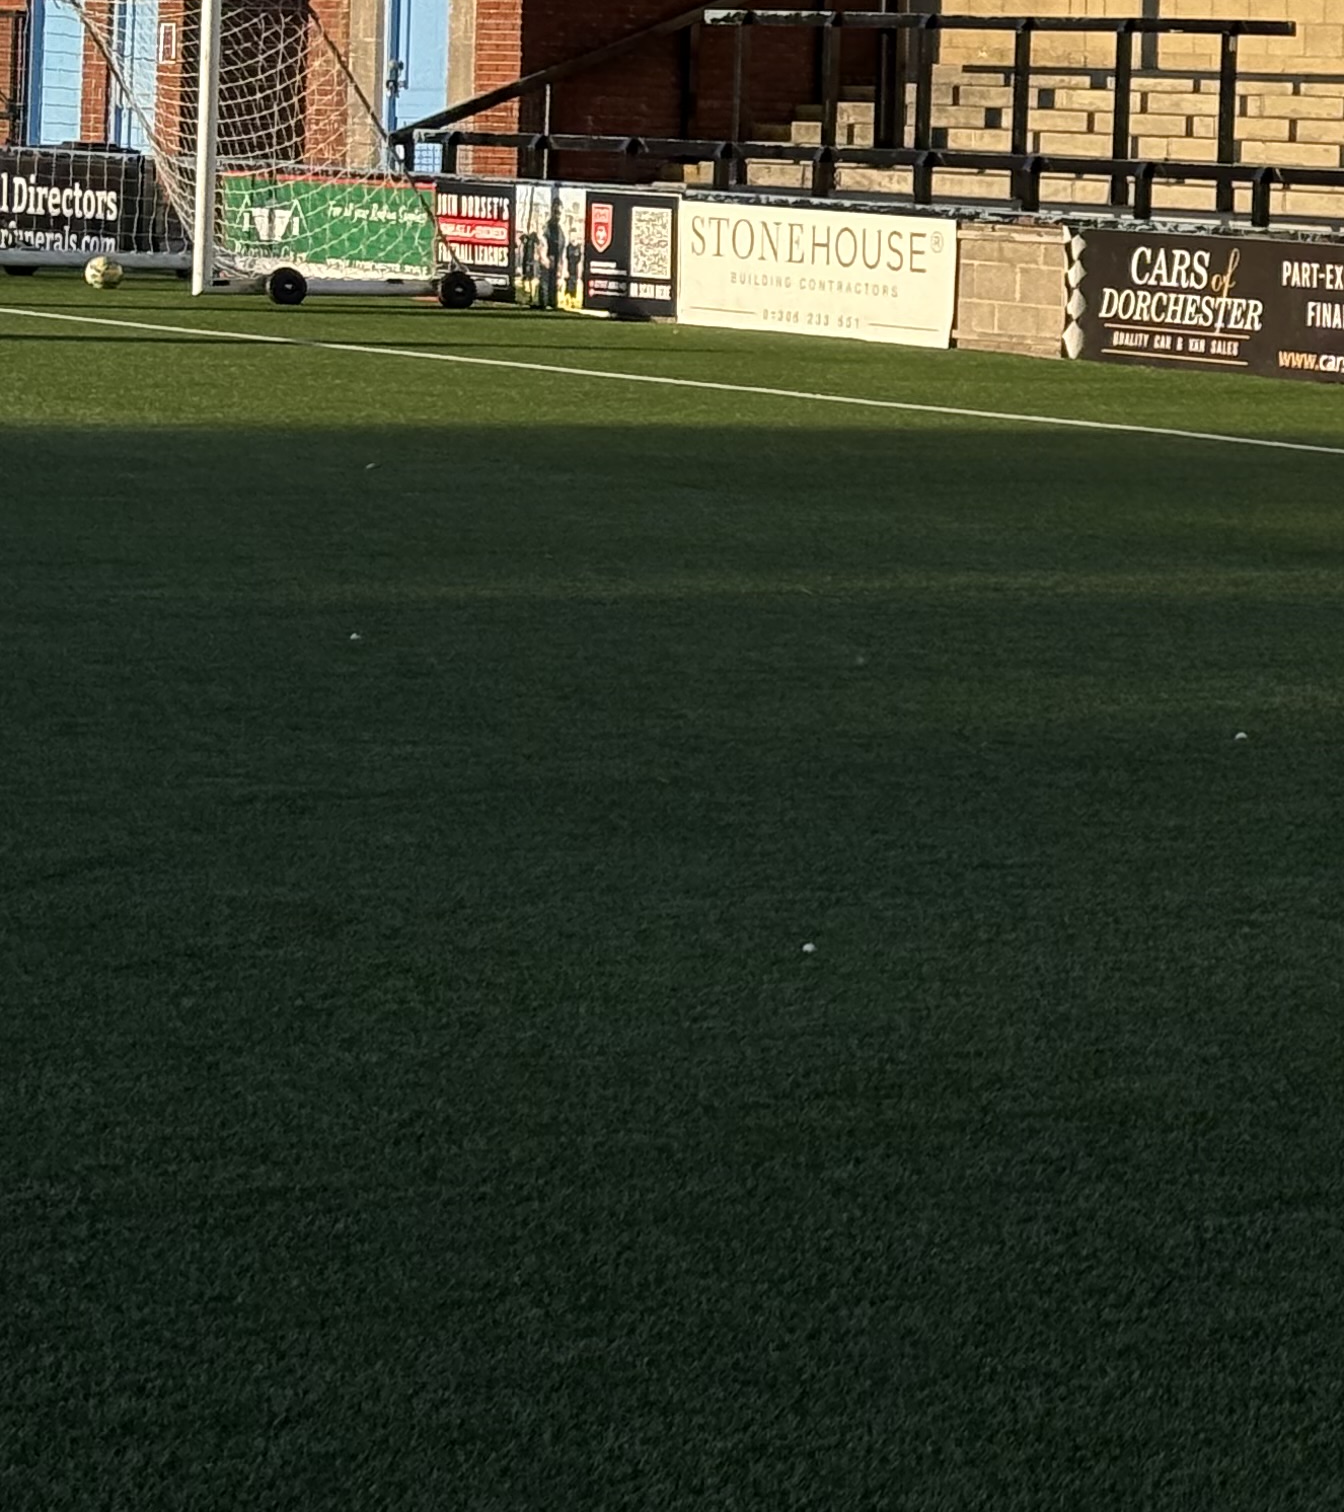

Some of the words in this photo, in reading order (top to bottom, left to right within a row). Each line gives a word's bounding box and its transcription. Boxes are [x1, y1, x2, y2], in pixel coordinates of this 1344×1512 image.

[12, 174, 118, 221] Directors
[437, 194, 458, 216] JOIN
[730, 270, 792, 289] BUILDING
[799, 277, 899, 298] CONTRACTORS
[1130, 246, 1211, 290] CARS
[1211, 248, 1241, 313] of
[1099, 288, 1264, 332] DORCHESTER
[1113, 330, 1149, 348] QUALITY
[1210, 340, 1240, 357] SALES
